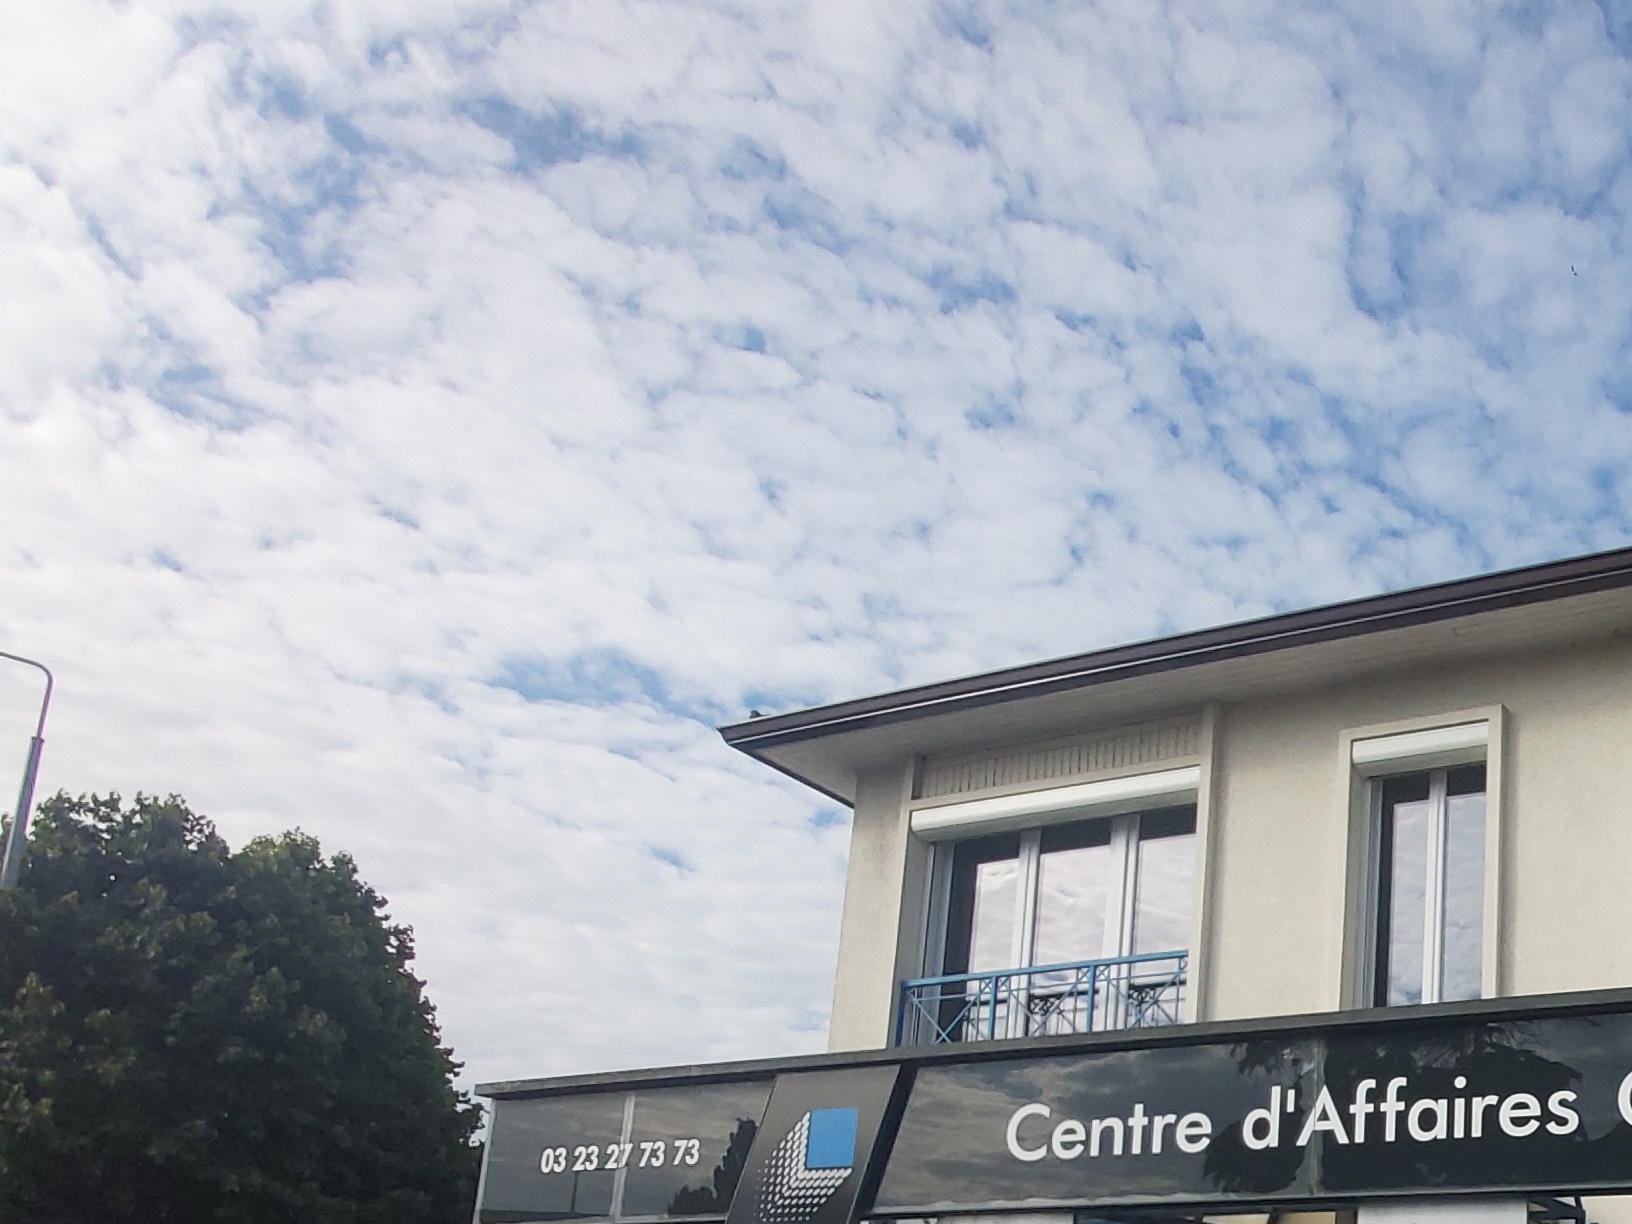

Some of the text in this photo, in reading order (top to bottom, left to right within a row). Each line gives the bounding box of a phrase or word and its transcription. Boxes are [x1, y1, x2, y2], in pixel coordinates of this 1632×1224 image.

[1005, 1103, 1212, 1161] Centre
[1243, 1076, 1580, 1150] d'Affaires
[541, 1138, 700, 1173] 03 23 27 73 73
